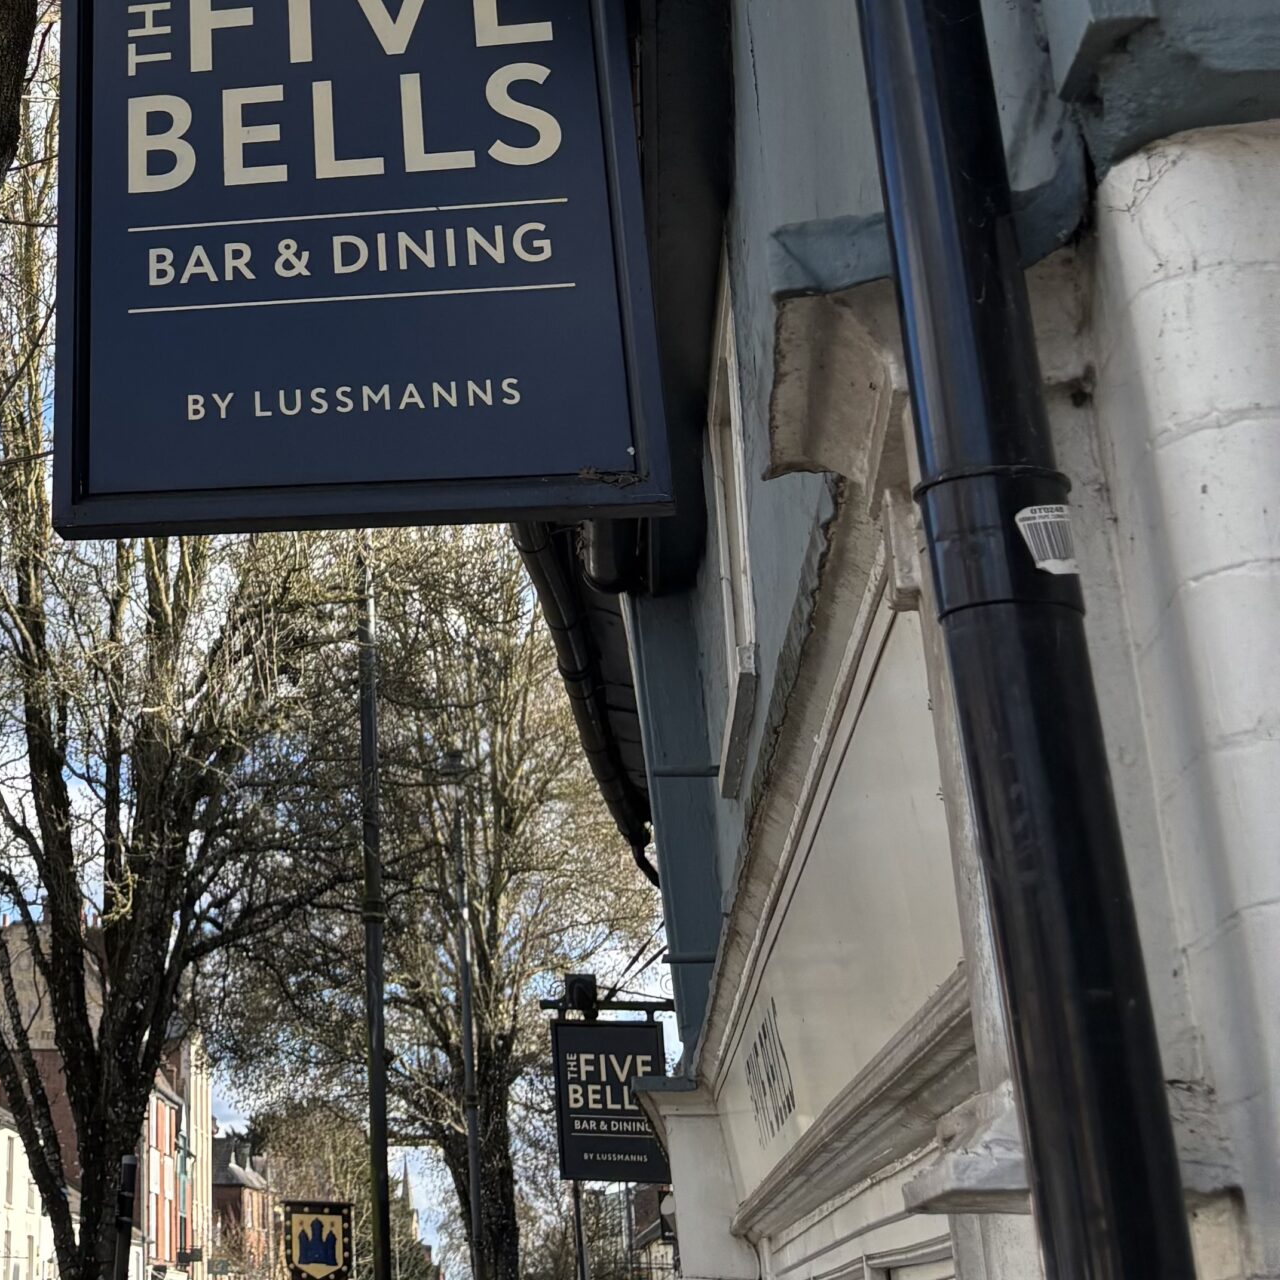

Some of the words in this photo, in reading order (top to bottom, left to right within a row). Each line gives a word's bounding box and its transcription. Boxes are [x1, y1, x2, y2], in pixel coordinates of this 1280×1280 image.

[127, 62, 563, 194] BELLS
[148, 241, 257, 286] BAR
[273, 238, 312, 278] &
[333, 221, 554, 276] DINING
[186, 392, 237, 421] BY
[254, 377, 522, 418] LUSSMANNS
[567, 1053, 578, 1080] THE
[568, 1084, 640, 1111] BELL
[575, 1119, 598, 1131] BAR
[600, 1120, 608, 1131] &
[597, 1153, 649, 1162] LUSSMANNS
